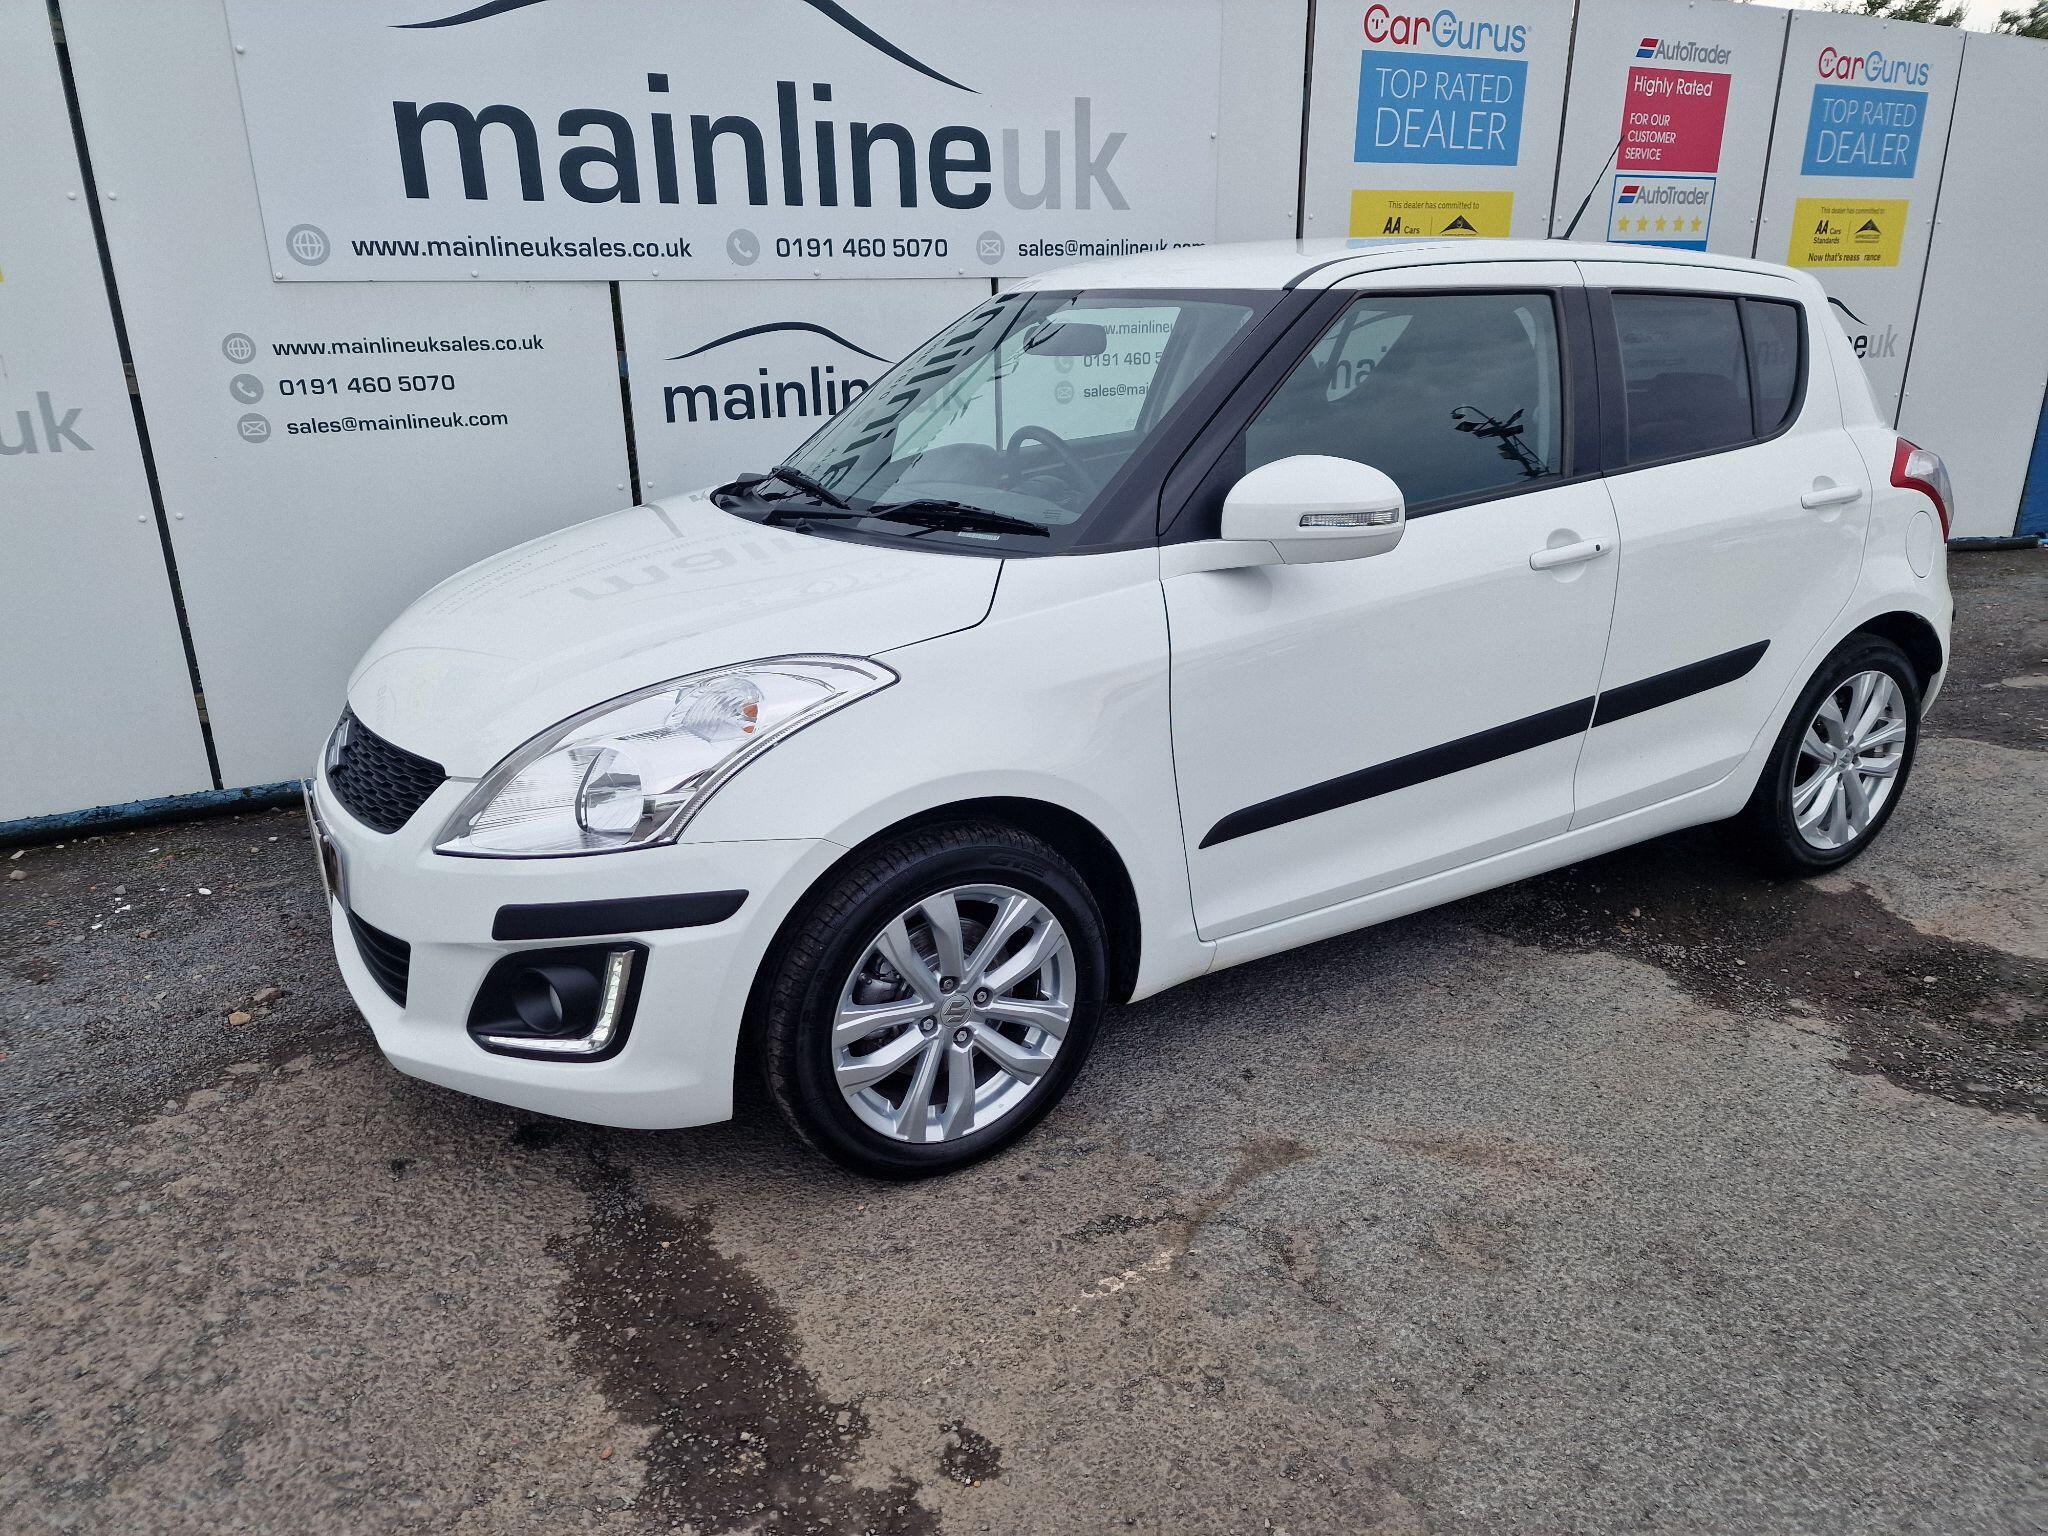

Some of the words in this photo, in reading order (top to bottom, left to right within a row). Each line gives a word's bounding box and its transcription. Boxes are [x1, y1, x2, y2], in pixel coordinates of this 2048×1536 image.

[1363, 3, 1527, 54] CarGurus
[1654, 39, 1732, 65] AutoTrader
[1818, 46, 1930, 86] CarGurus
[1375, 67, 1428, 99] TOP
[1434, 71, 1513, 104] RATED
[1634, 75, 1674, 98] Highly
[1676, 78, 1713, 97] Rated
[1629, 112, 1649, 125] FOR
[1650, 113, 1671, 127] OUR
[1823, 97, 1859, 124] TOP
[1861, 100, 1917, 128] RATED
[1375, 107, 1507, 150] DEALER
[1627, 129, 1677, 144] CUSTOMER
[1625, 147, 1662, 161] SERVICE
[1816, 129, 1910, 166] DEALER
[1388, 200, 1402, 209] This
[1403, 201, 1424, 209] dealer
[1437, 201, 1472, 209] committed
[1635, 186, 1709, 205] AutoTrader
[1382, 216, 1402, 235] AA
[1403, 225, 1421, 235] Cars
[1814, 219, 1830, 235] AA
[1829, 227, 1841, 235] Cars
[351, 235, 692, 258] www.mainlineuksales.co.uk
[776, 237, 833, 258] 0191
[842, 237, 886, 258] 460
[892, 237, 948, 258] 5070
[1812, 236, 1840, 244] Standards
[1807, 252, 1824, 262] Now
[1824, 252, 1843, 261] that's
[272, 334, 545, 356] www.mainlineuksales.co.uk
[1123, 351, 1151, 366] 460
[279, 376, 338, 396] 0191
[347, 376, 392, 393] 460
[397, 374, 455, 392] 5070
[286, 411, 509, 435] sales@mainlineuk.com
